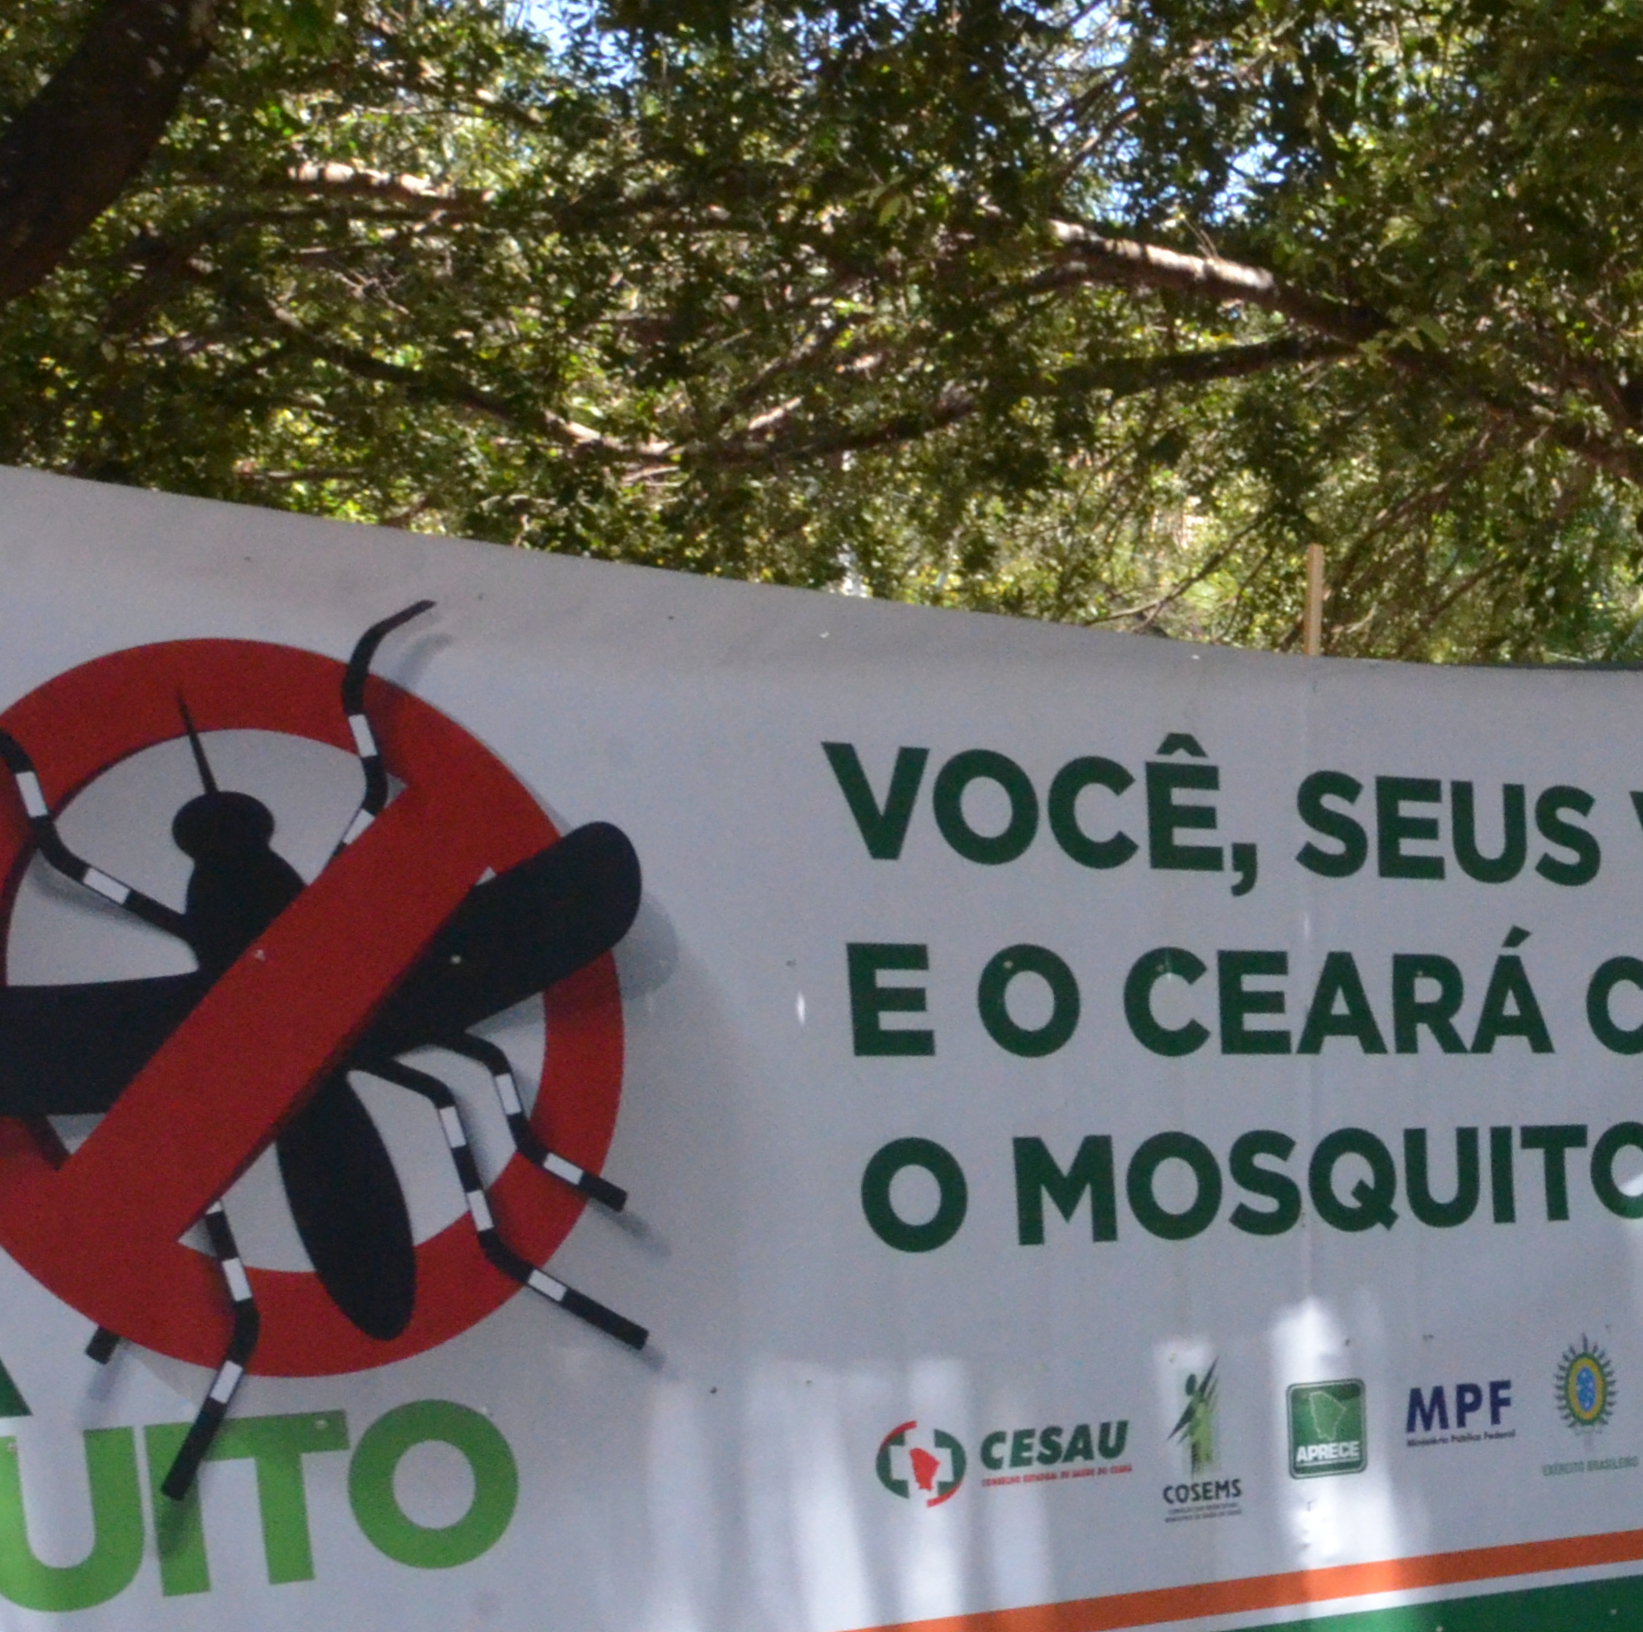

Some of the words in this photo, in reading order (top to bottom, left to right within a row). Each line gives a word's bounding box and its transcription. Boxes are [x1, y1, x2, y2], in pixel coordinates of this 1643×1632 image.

[821, 731, 1260, 897] VOCÊ,
[1294, 768, 1603, 888] SEUS
[845, 942, 937, 1057] E
[977, 943, 1081, 1059] O
[1123, 925, 1556, 1059] CEARÁ
[860, 1136, 969, 1255] O
[1404, 1379, 1514, 1434] MPF
[979, 1420, 1130, 1471] CESAU
[1296, 1440, 1361, 1463] APRECE
[1162, 1478, 1243, 1505] COSEMS
